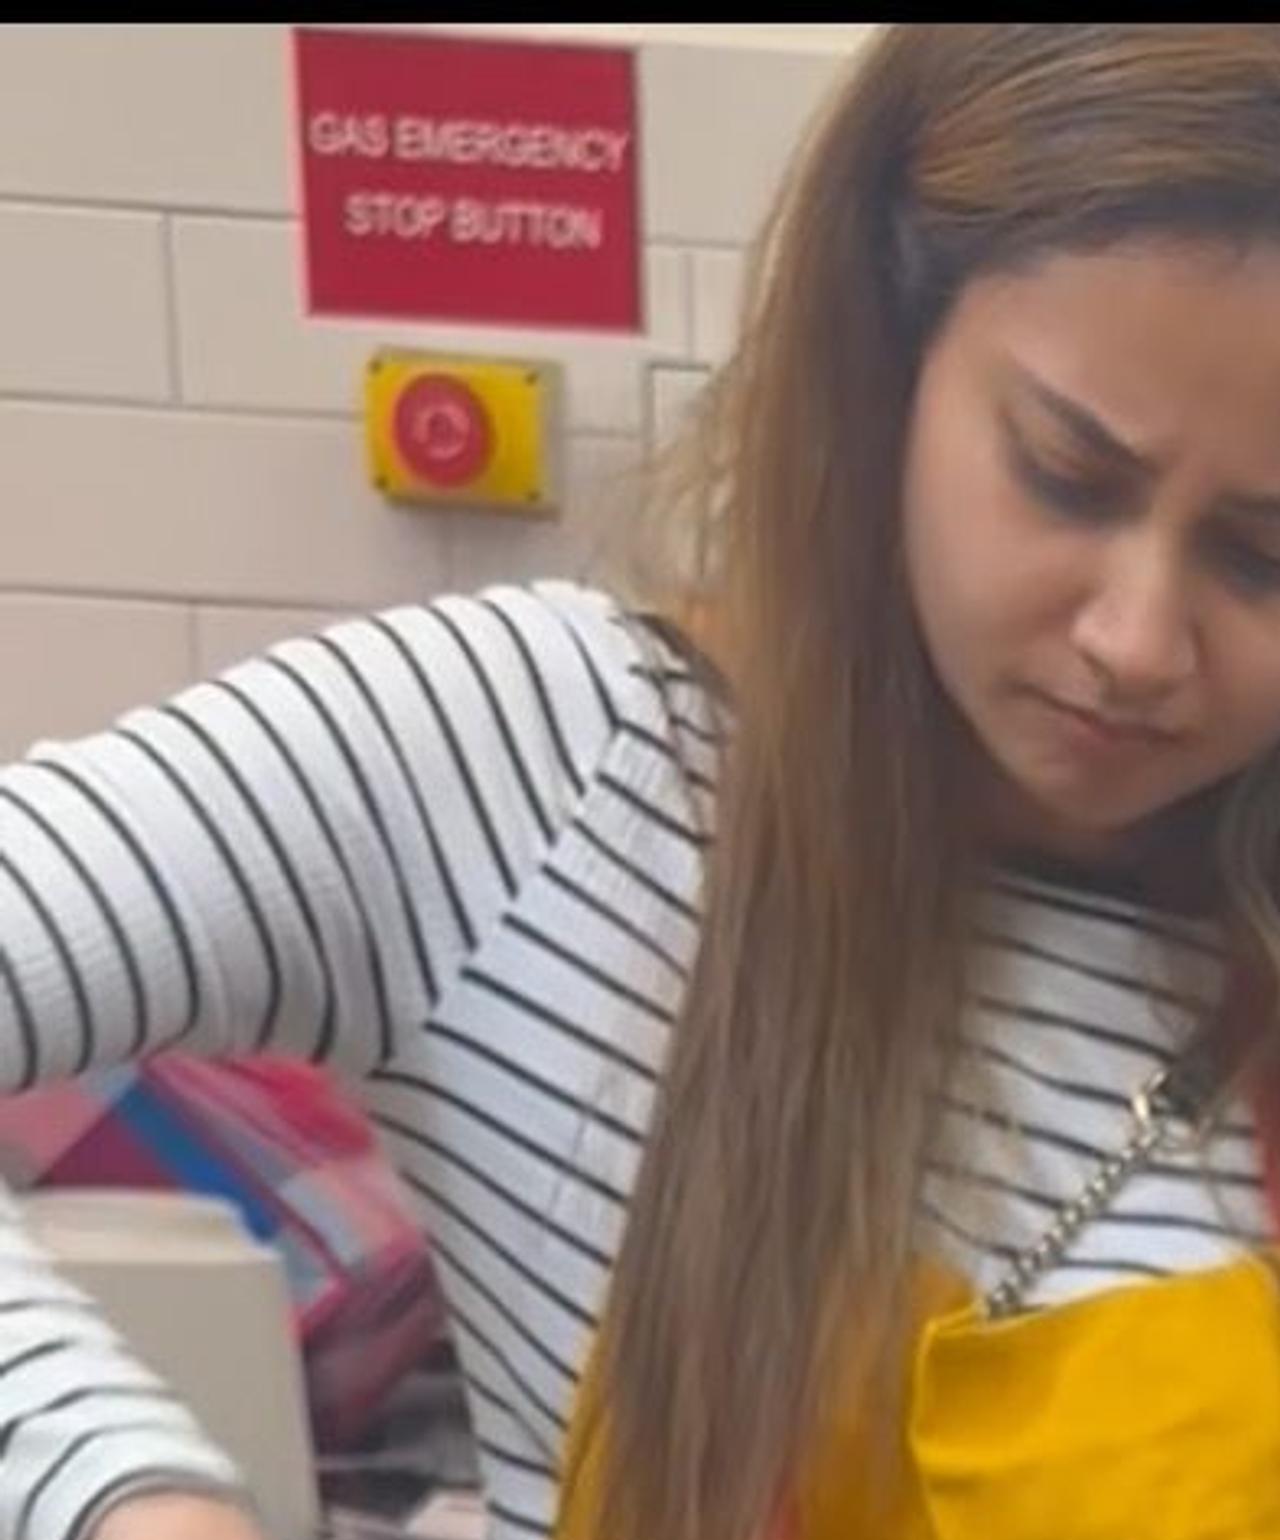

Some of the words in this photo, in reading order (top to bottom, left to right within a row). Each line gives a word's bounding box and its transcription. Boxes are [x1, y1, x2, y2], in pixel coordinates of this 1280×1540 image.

[308, 112, 389, 158] GAS
[393, 115, 628, 172] EMERGENCY
[344, 193, 445, 238] STOP
[451, 197, 603, 250] BUTTON
